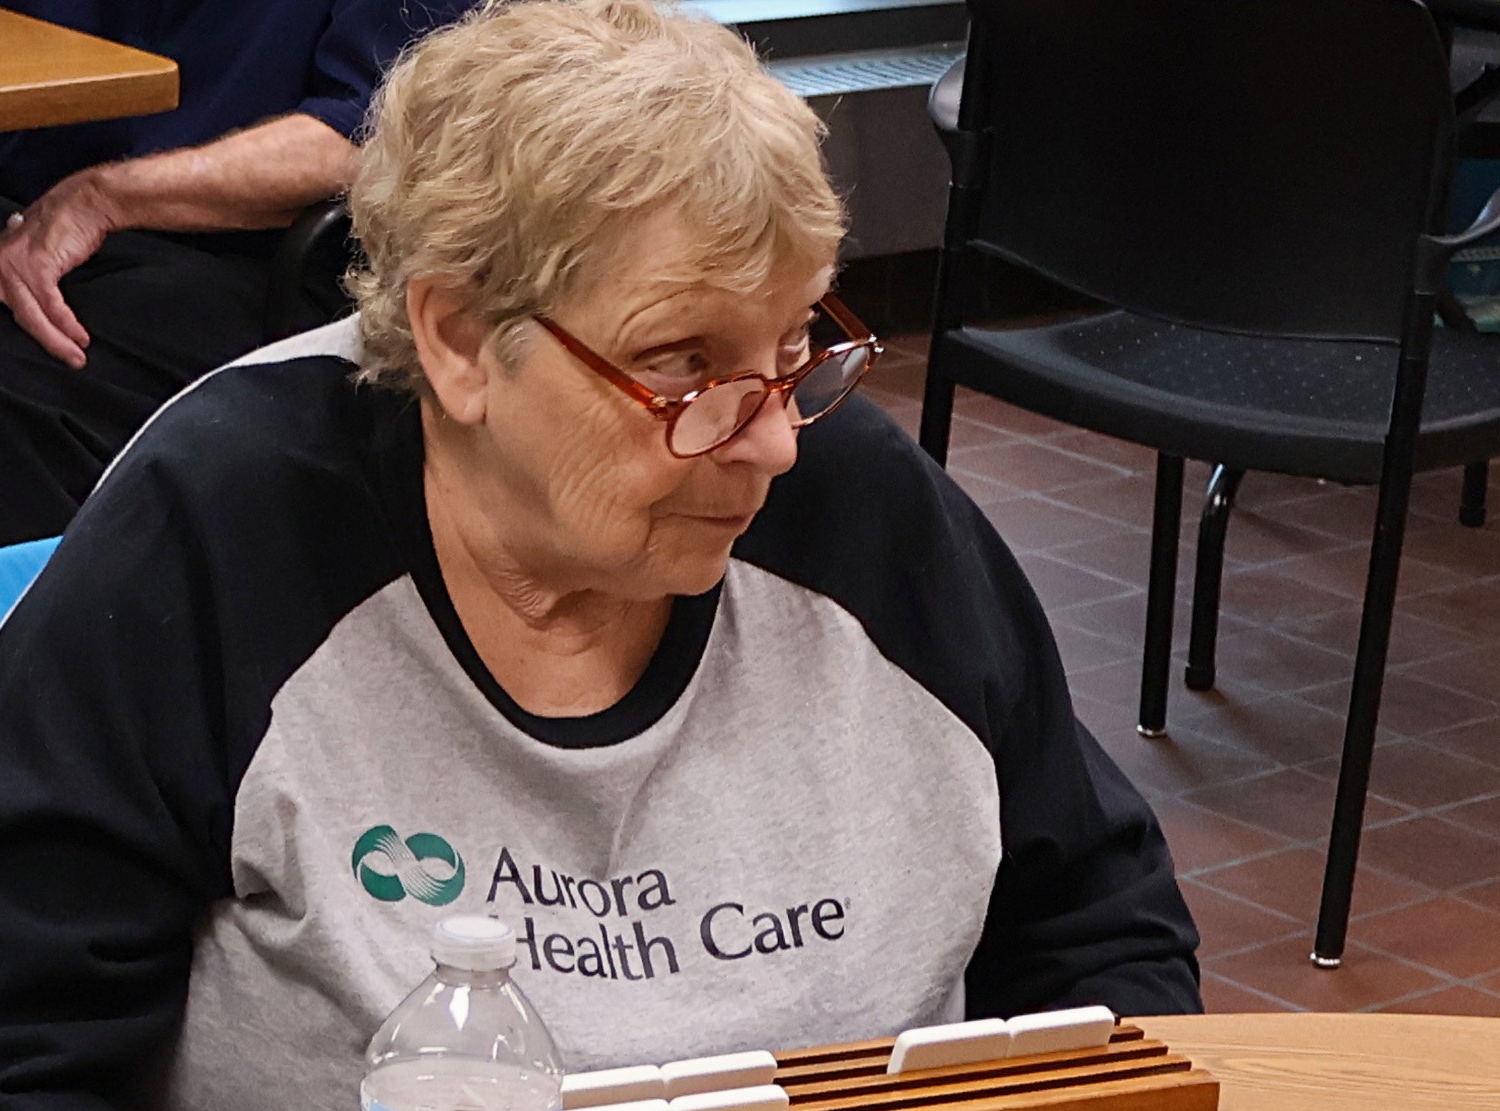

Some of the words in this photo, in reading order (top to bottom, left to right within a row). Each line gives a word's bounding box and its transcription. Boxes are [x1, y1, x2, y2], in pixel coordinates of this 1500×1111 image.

[486, 847, 675, 917] Aurora
[513, 917, 680, 980] Health
[700, 898, 845, 961] Care
